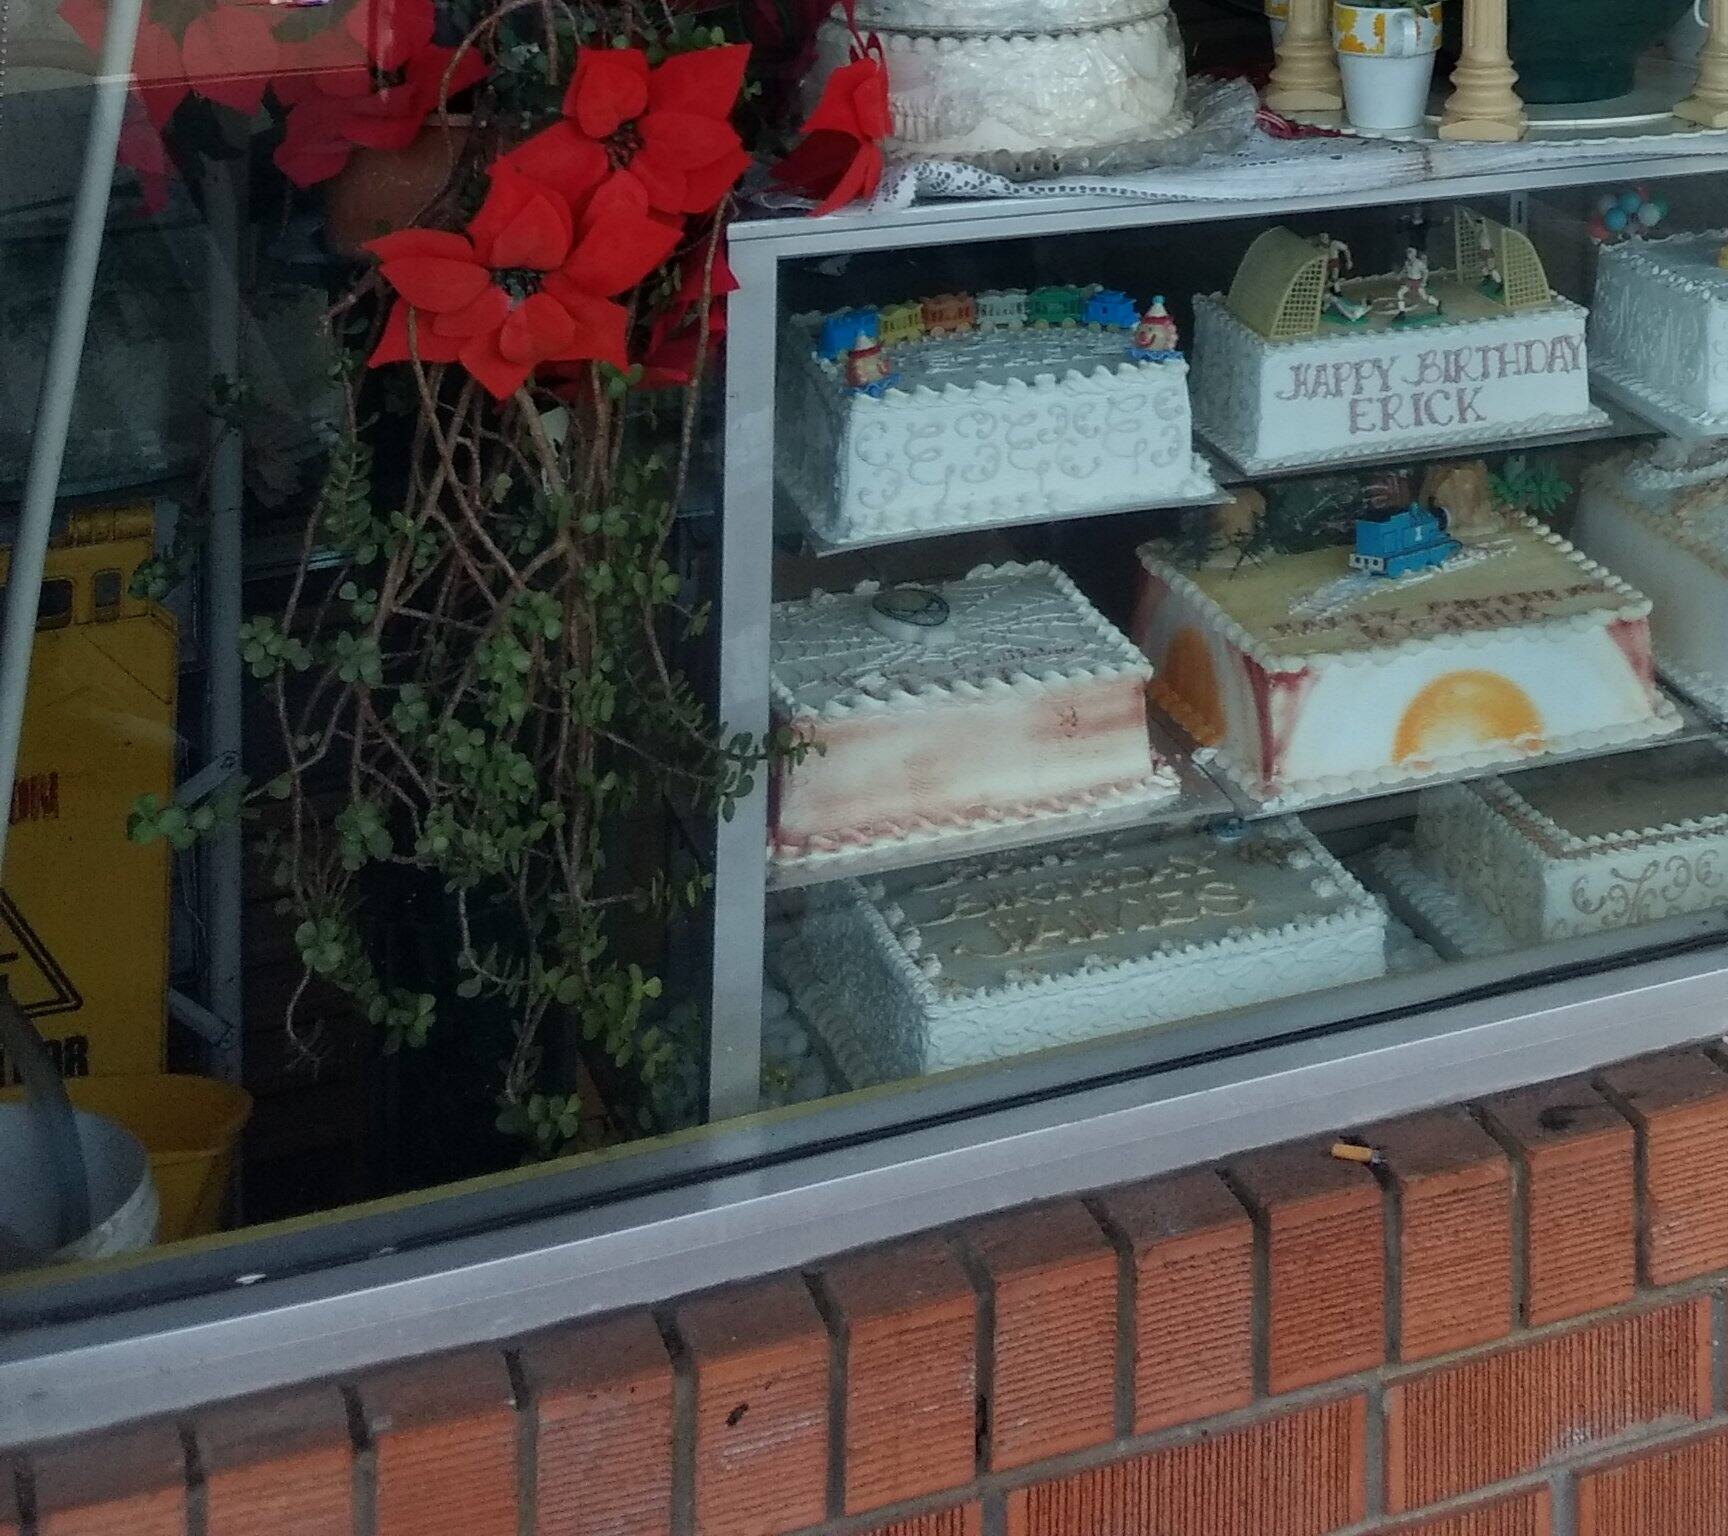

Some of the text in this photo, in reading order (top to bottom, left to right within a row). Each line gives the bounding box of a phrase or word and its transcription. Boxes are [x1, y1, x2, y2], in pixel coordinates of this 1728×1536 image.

[1275, 332, 1586, 401] HAPPY BIRTHDAY
[1347, 384, 1488, 435] ERICK
